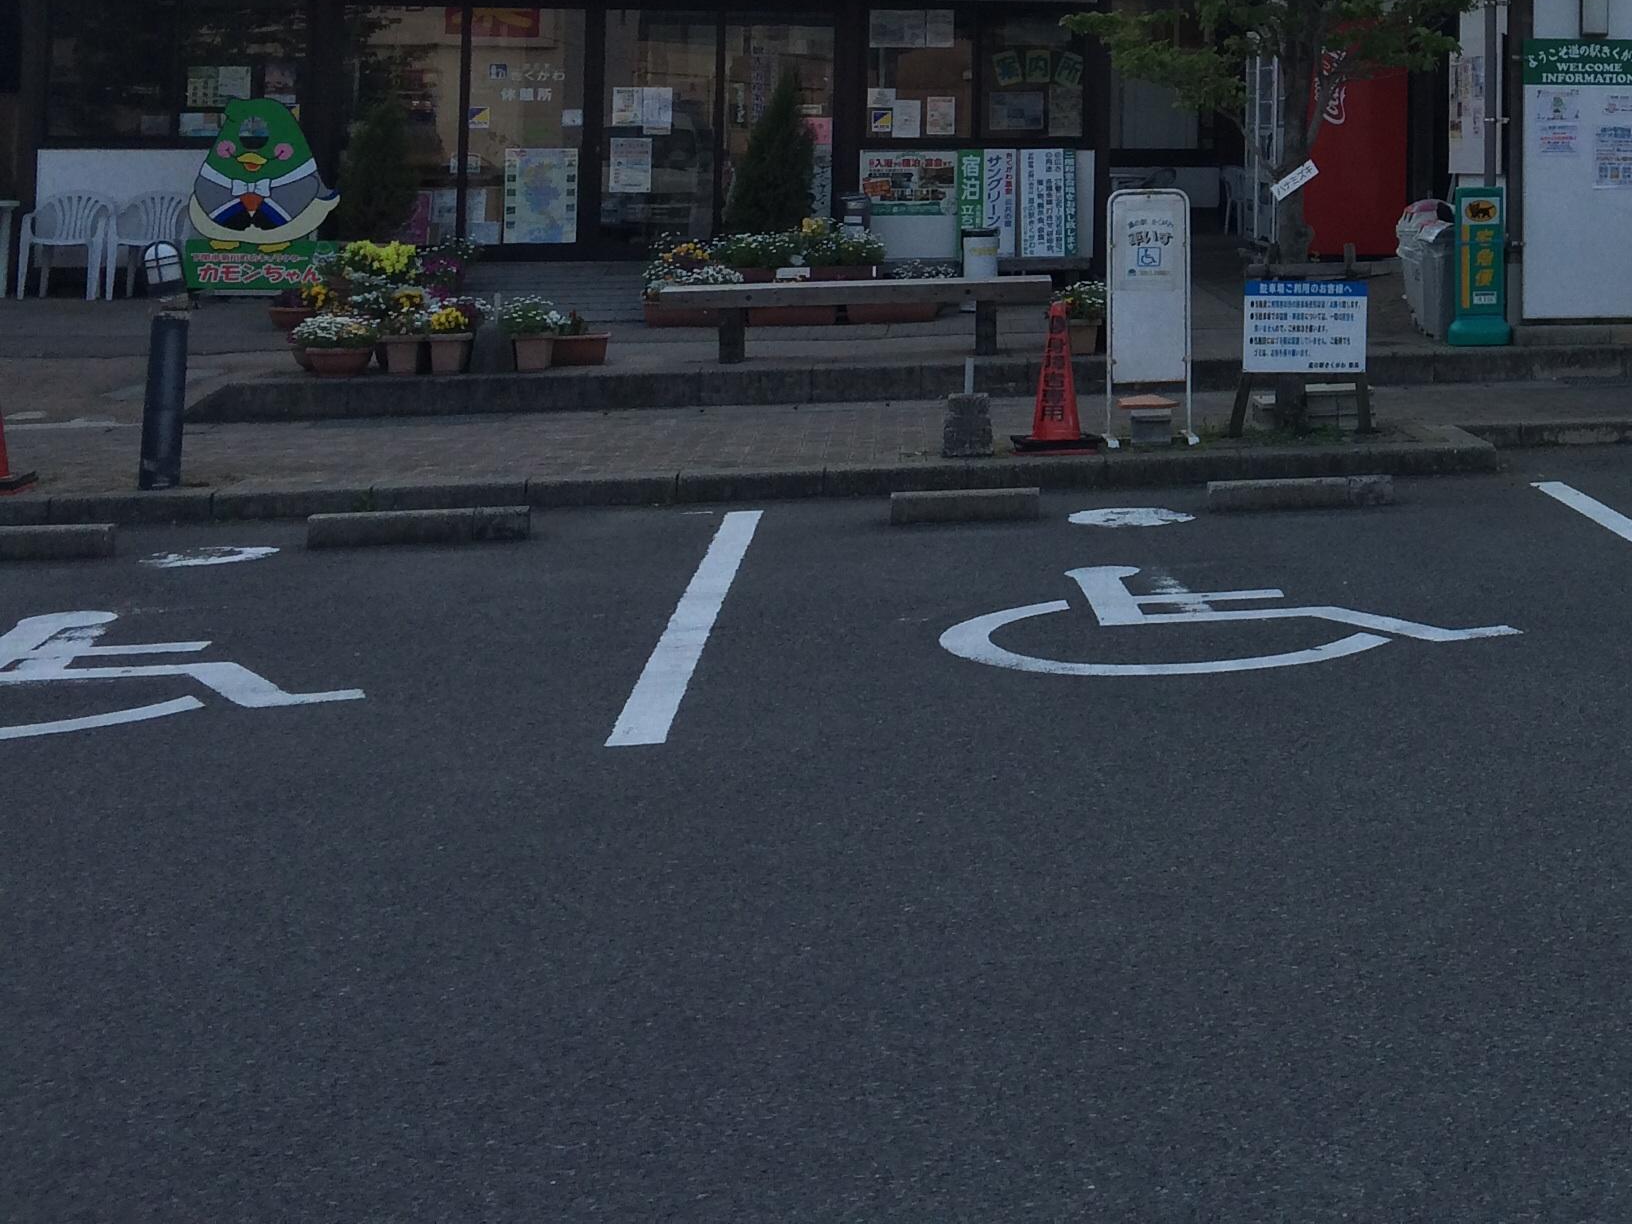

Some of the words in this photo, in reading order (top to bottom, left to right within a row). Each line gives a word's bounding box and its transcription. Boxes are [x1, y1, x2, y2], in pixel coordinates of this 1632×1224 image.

[995, 53, 1081, 83] 案内所
[1556, 62, 1623, 73] WELCOME
[961, 153, 981, 200] 宿泊
[987, 155, 1002, 227] サングリーン
[197, 263, 323, 285] カモンちゃん
[1259, 283, 1353, 295] 駐車場ご利用のお客様へ
